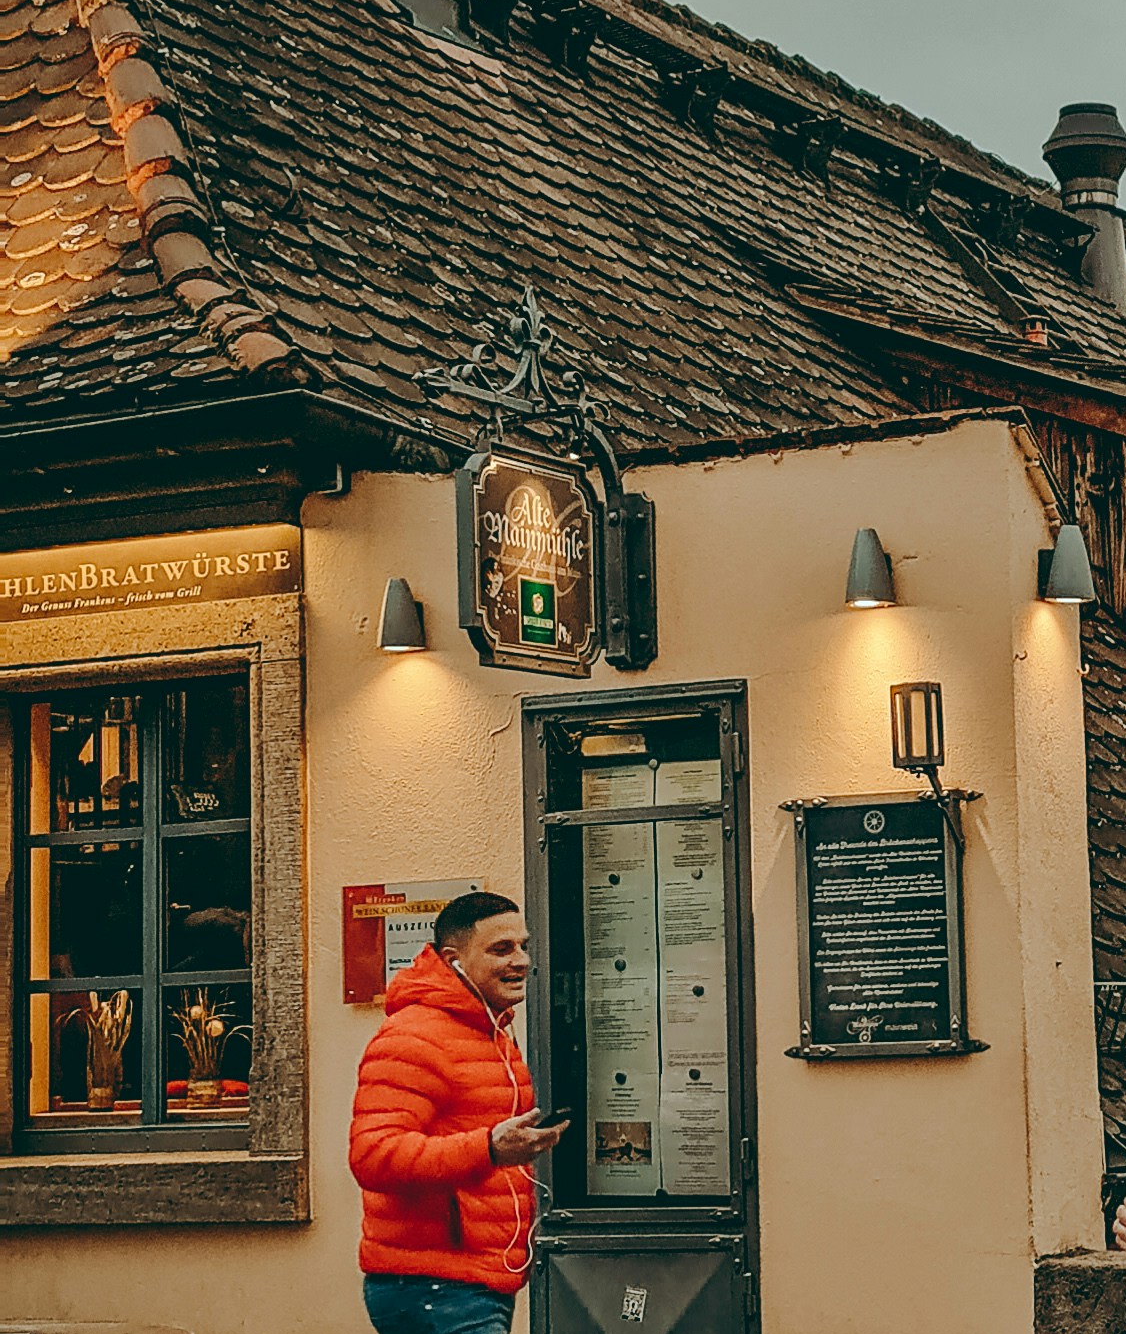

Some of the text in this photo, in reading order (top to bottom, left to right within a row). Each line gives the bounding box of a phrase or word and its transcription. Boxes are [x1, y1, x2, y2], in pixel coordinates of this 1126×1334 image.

[511, 492, 551, 528] Alte
[483, 510, 584, 567] Mainmühle
[21, 603, 39, 614] Der
[41, 601, 72, 612] Genuss
[73, 595, 115, 609] Frankens
[124, 590, 153, 606] frisch
[154, 591, 174, 600] vom
[176, 585, 202, 597] Grill
